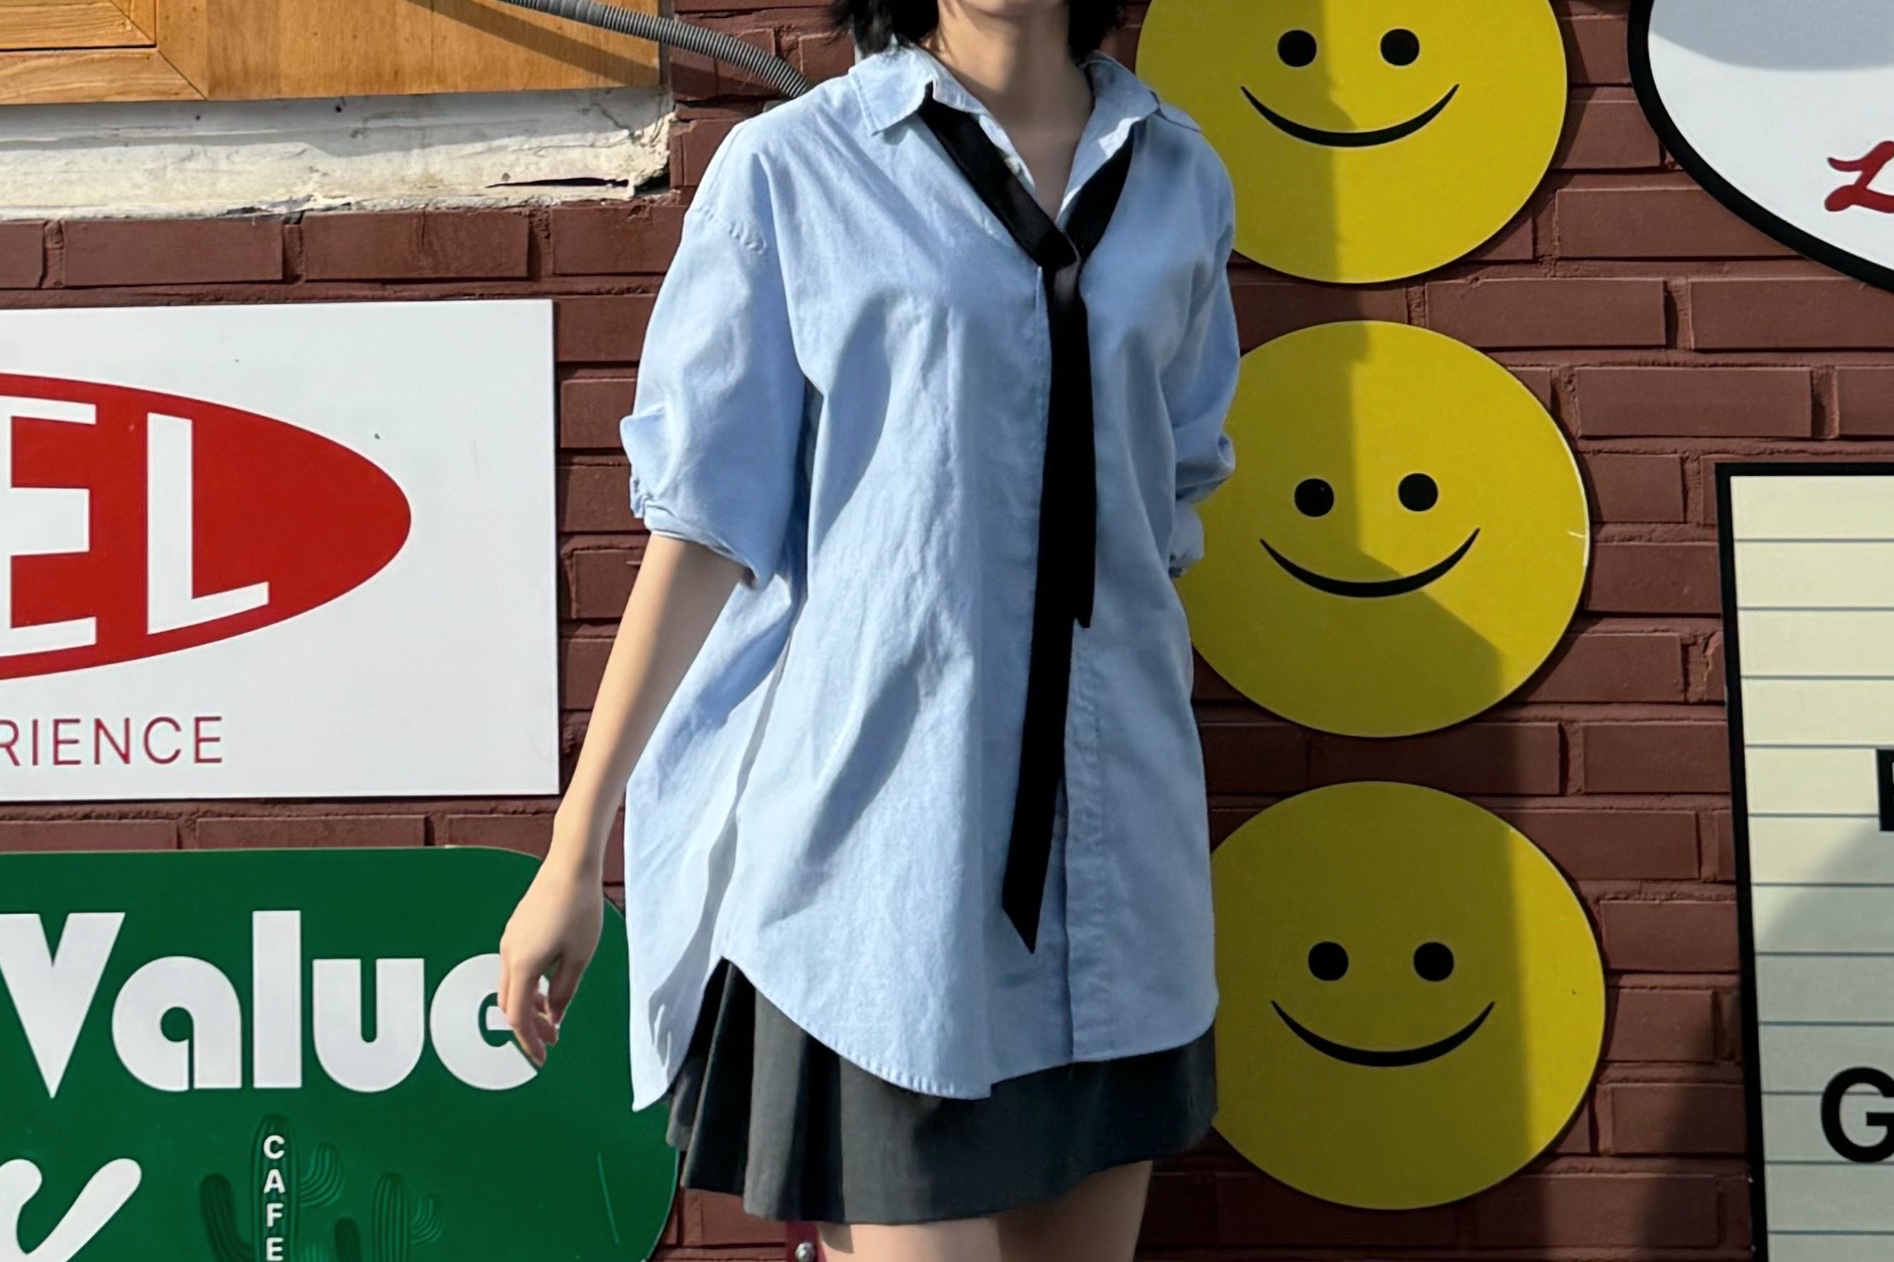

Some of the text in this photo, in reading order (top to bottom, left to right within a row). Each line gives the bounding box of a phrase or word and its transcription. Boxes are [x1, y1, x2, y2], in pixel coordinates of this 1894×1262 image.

[0, 716, 222, 767] RIENCE
[0, 910, 549, 1098] Value
[1821, 1066, 1894, 1163] G
[263, 1135, 286, 1262] CAFE
